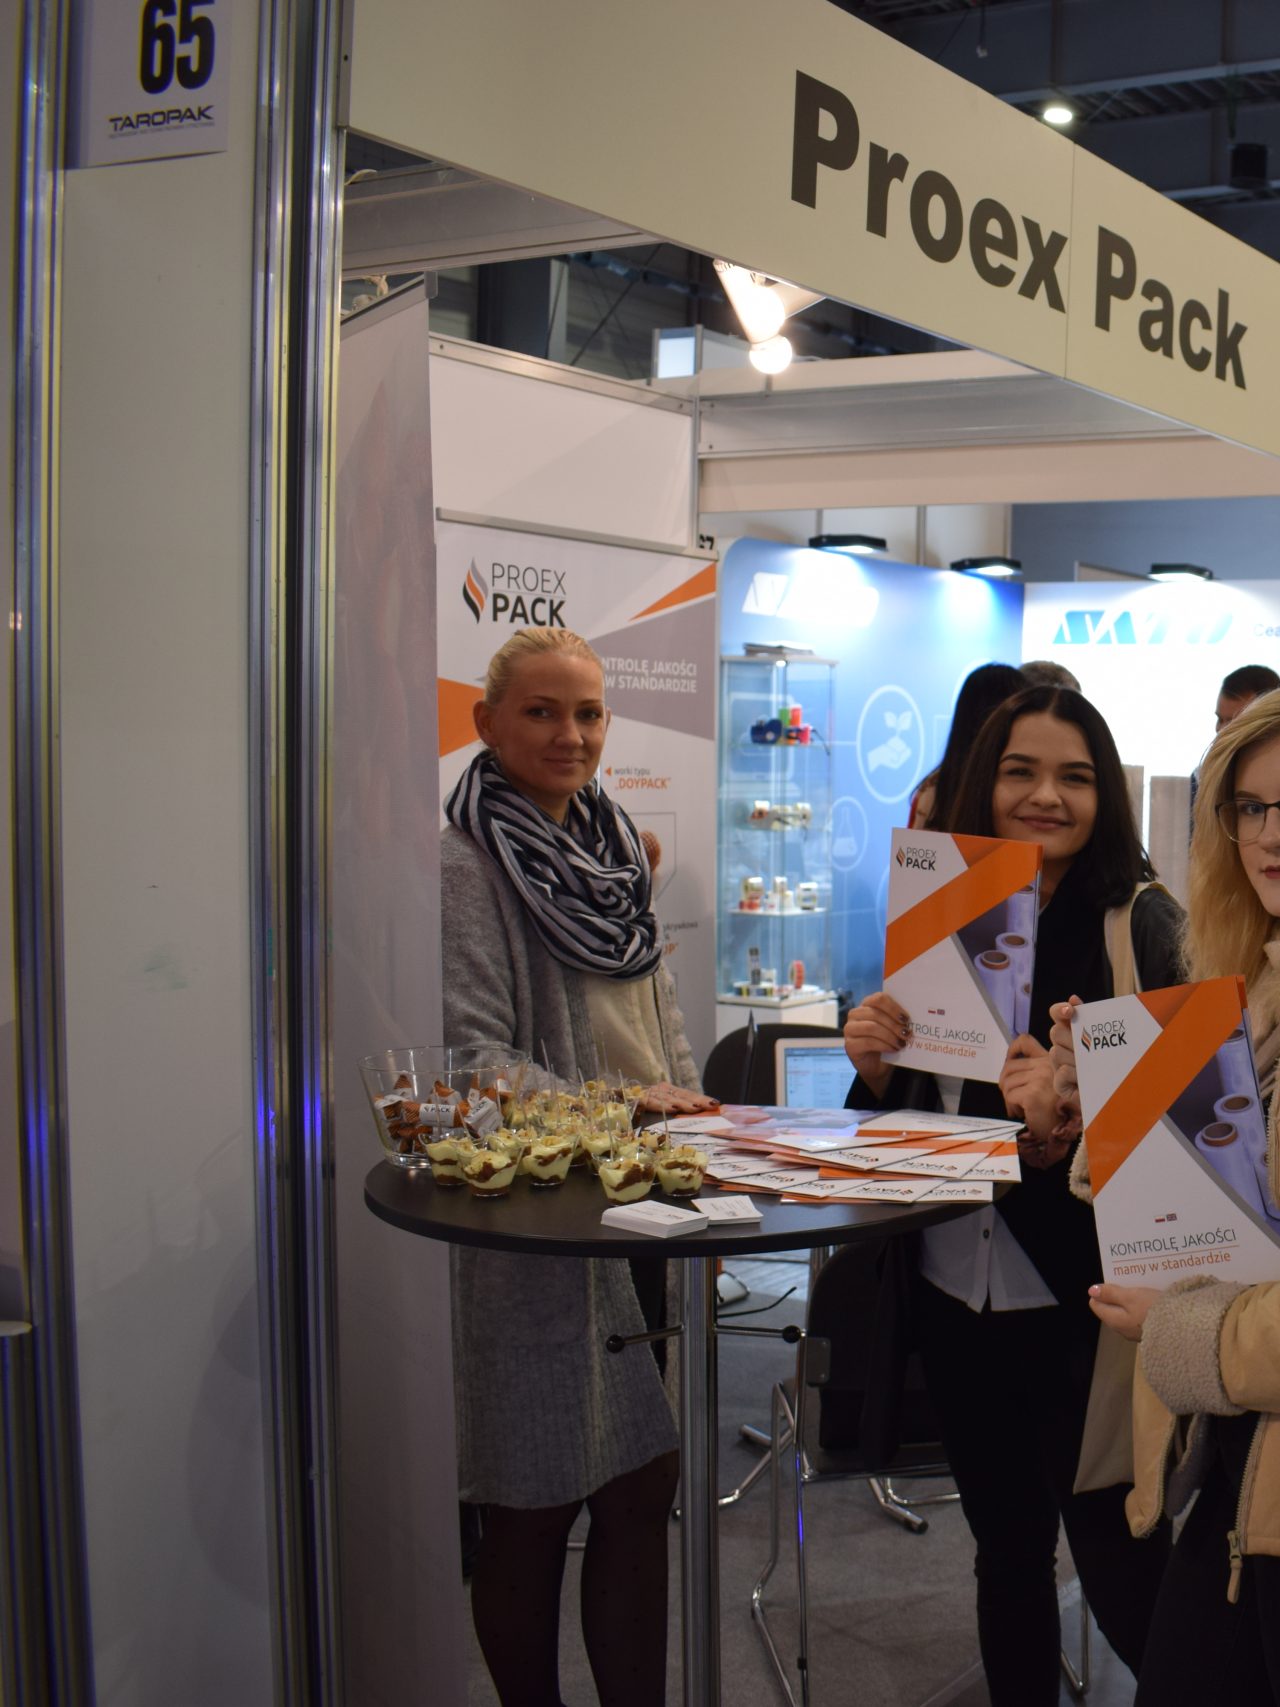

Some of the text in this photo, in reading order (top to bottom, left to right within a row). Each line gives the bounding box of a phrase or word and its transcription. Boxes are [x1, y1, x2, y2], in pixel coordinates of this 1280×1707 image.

[139, 0, 216, 95] 65
[108, 105, 215, 132] TAROPAK
[791, 69, 1248, 391] Proex Pack
[491, 562, 567, 595] PROEX
[492, 593, 567, 628] PACK
[601, 657, 697, 677] NTROLĘ JAKOŚCI
[618, 675, 697, 693] STANDARDZIE
[906, 846, 937, 860] PROEX
[906, 858, 936, 871] PACK
[942, 1025, 986, 1044] JAKOŚCI
[1090, 1019, 1126, 1034] PROEX
[924, 1042, 977, 1058] standardzie
[1093, 1032, 1128, 1050] PACK
[1110, 1227, 1237, 1257] KONTROLĘ JAKOŚCI
[1113, 1250, 1232, 1277] mamy w standardzie
